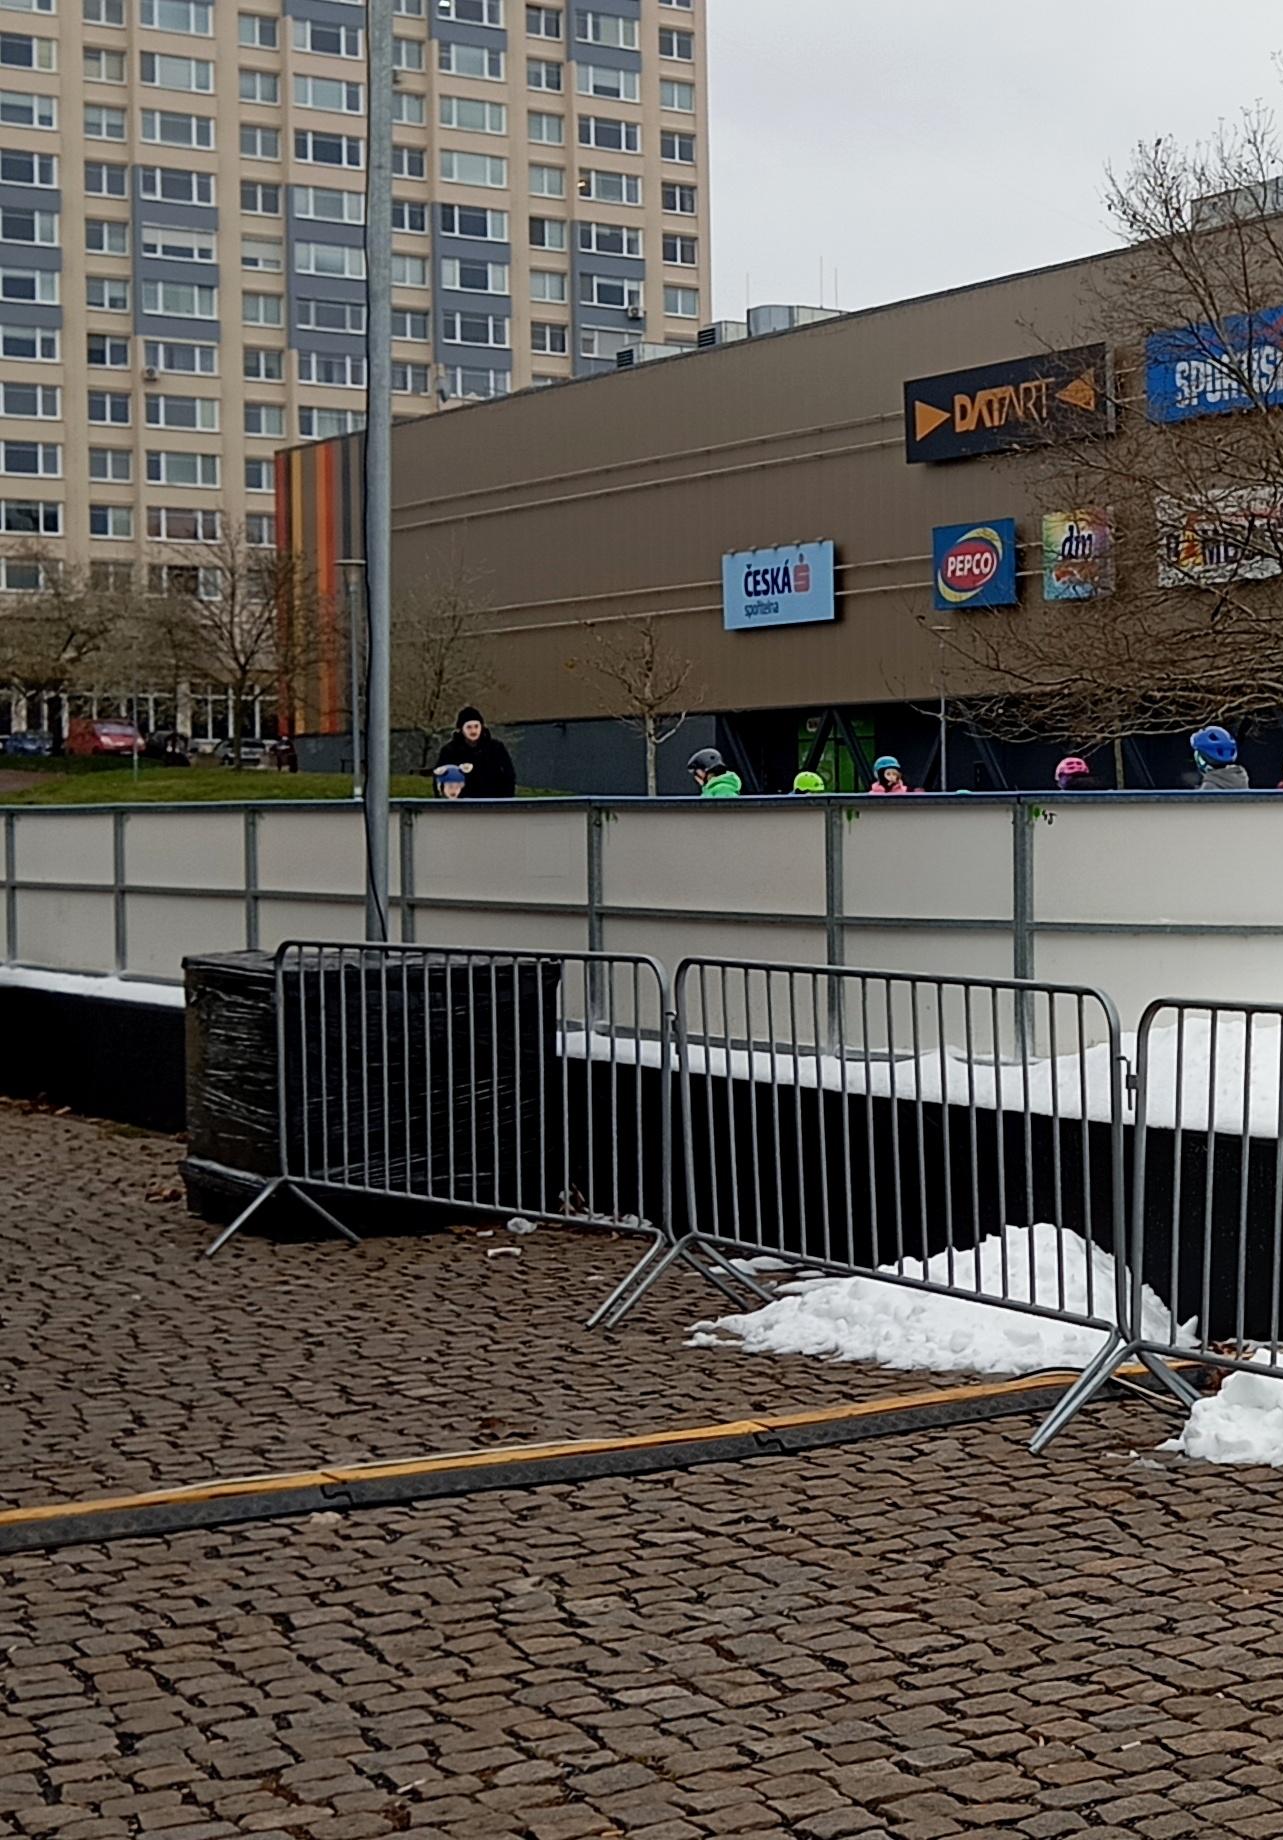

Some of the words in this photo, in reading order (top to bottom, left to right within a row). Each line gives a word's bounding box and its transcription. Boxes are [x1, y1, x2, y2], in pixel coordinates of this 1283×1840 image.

[953, 377, 1056, 433] DATART
[1061, 523, 1094, 560] dm
[743, 558, 793, 598] ČESKÁ
[947, 551, 993, 578] PEPCO
